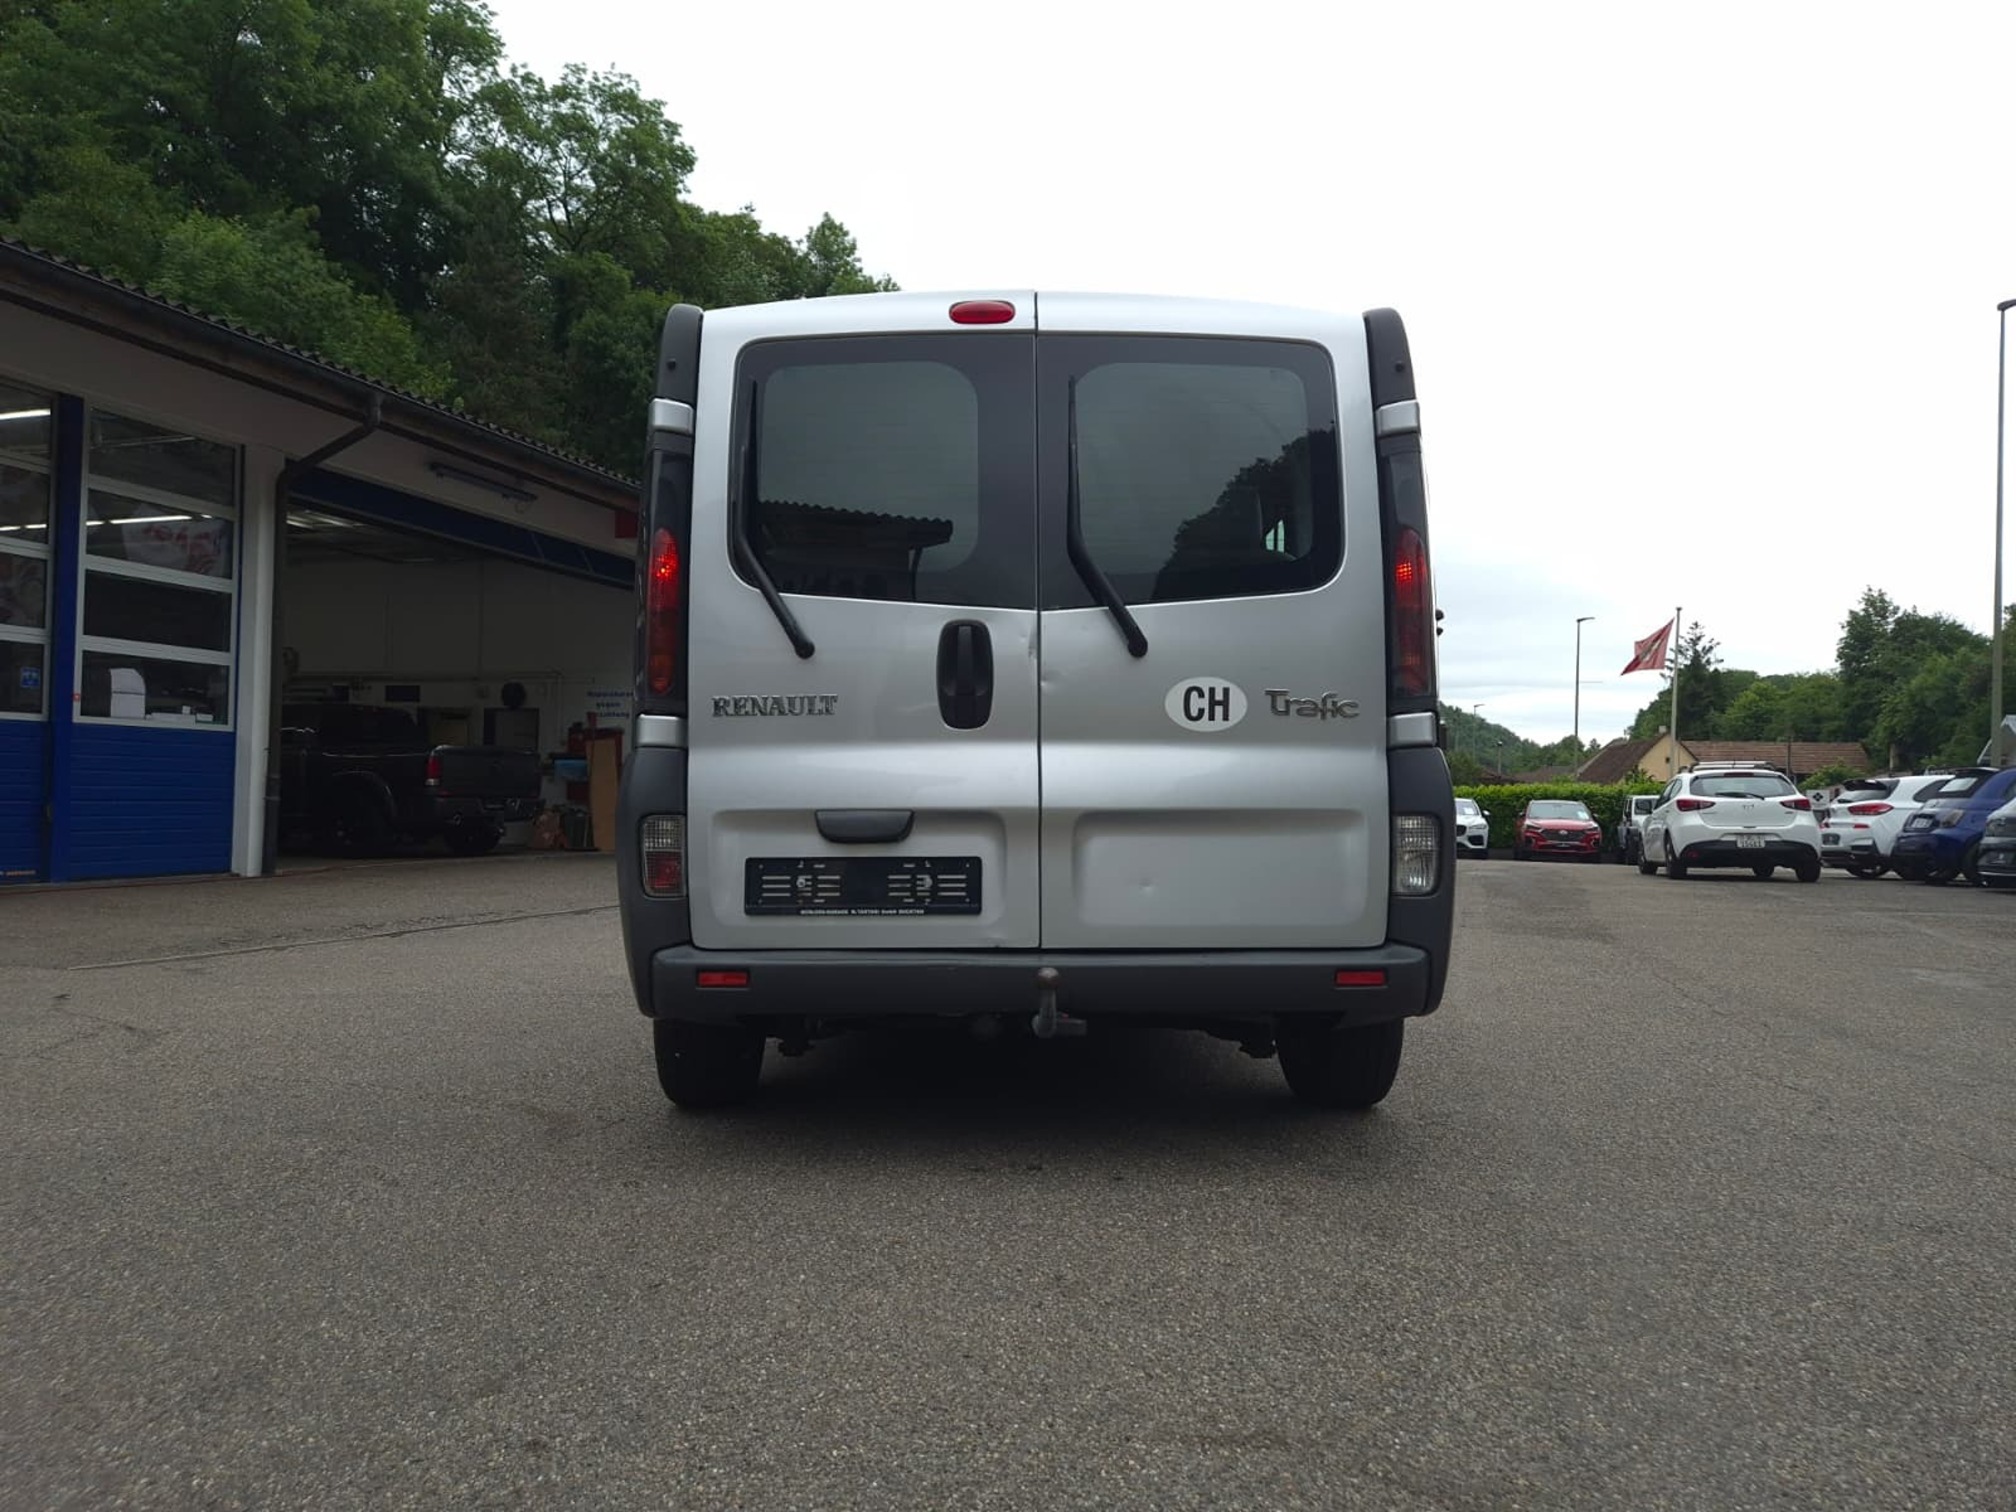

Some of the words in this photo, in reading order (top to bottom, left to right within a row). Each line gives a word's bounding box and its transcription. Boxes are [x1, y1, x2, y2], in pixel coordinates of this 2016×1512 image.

[711, 693, 839, 717] RENAULT
[1183, 686, 1230, 721] CH
[1264, 688, 1360, 720] Trafic
